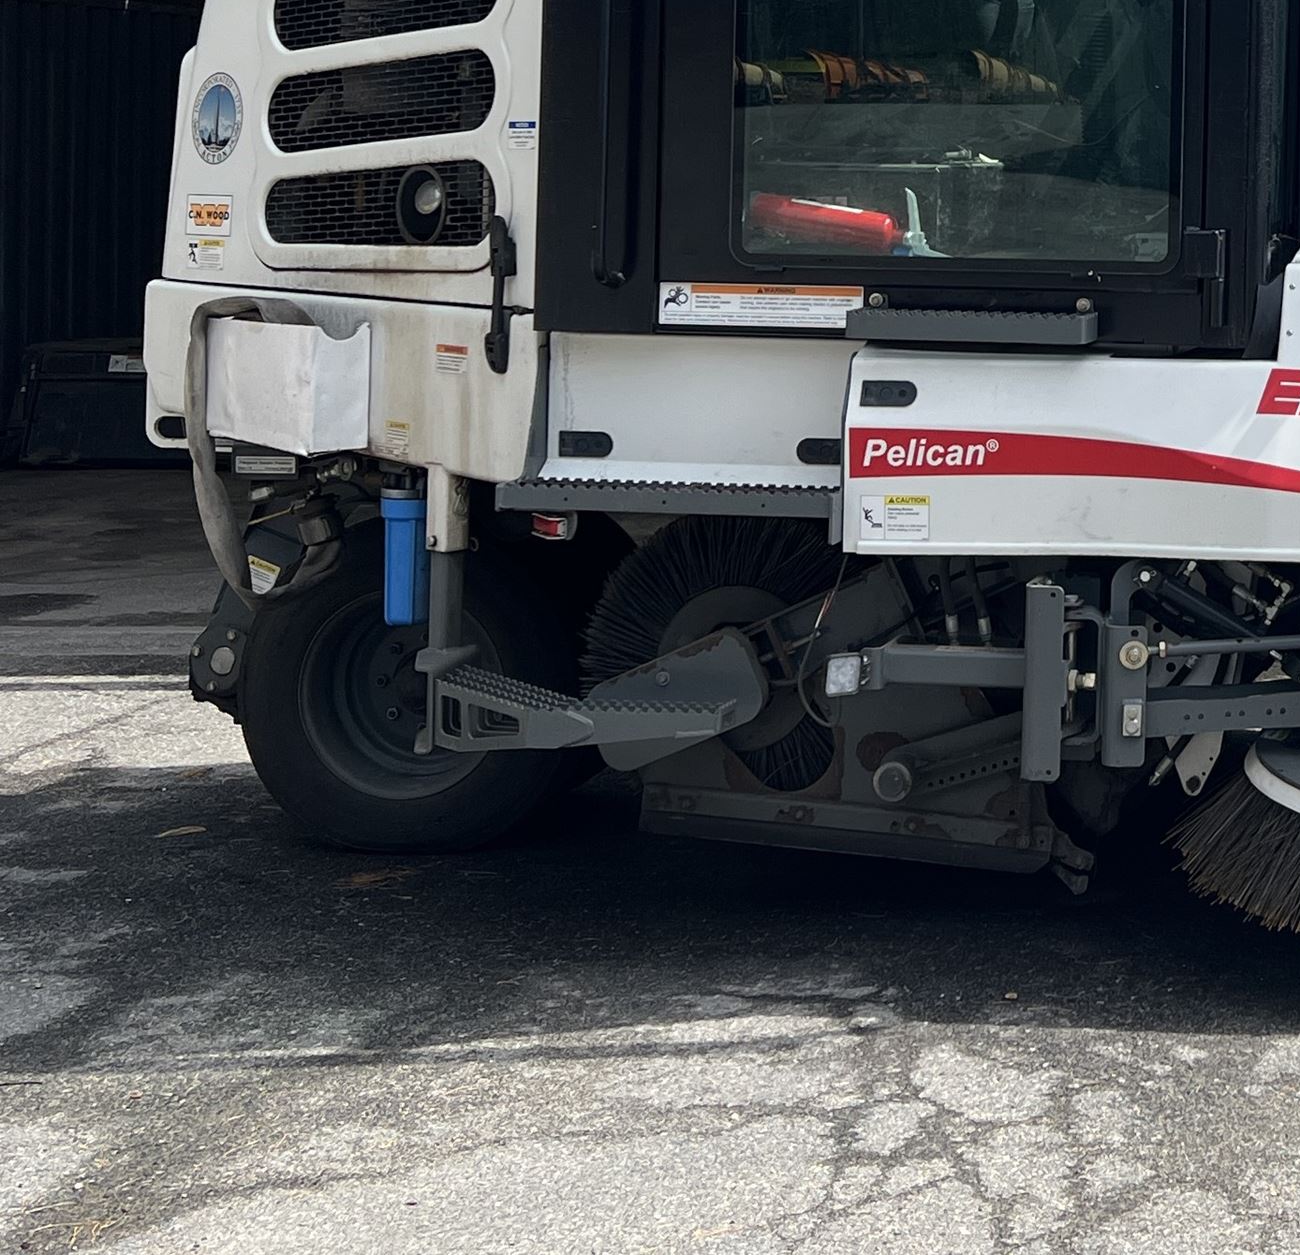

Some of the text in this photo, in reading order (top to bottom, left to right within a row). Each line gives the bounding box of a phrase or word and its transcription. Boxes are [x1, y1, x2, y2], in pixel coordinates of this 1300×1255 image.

[202, 150, 227, 163] ACTON
[206, 210, 230, 220] WOOD
[895, 496, 927, 504] CAUTION
